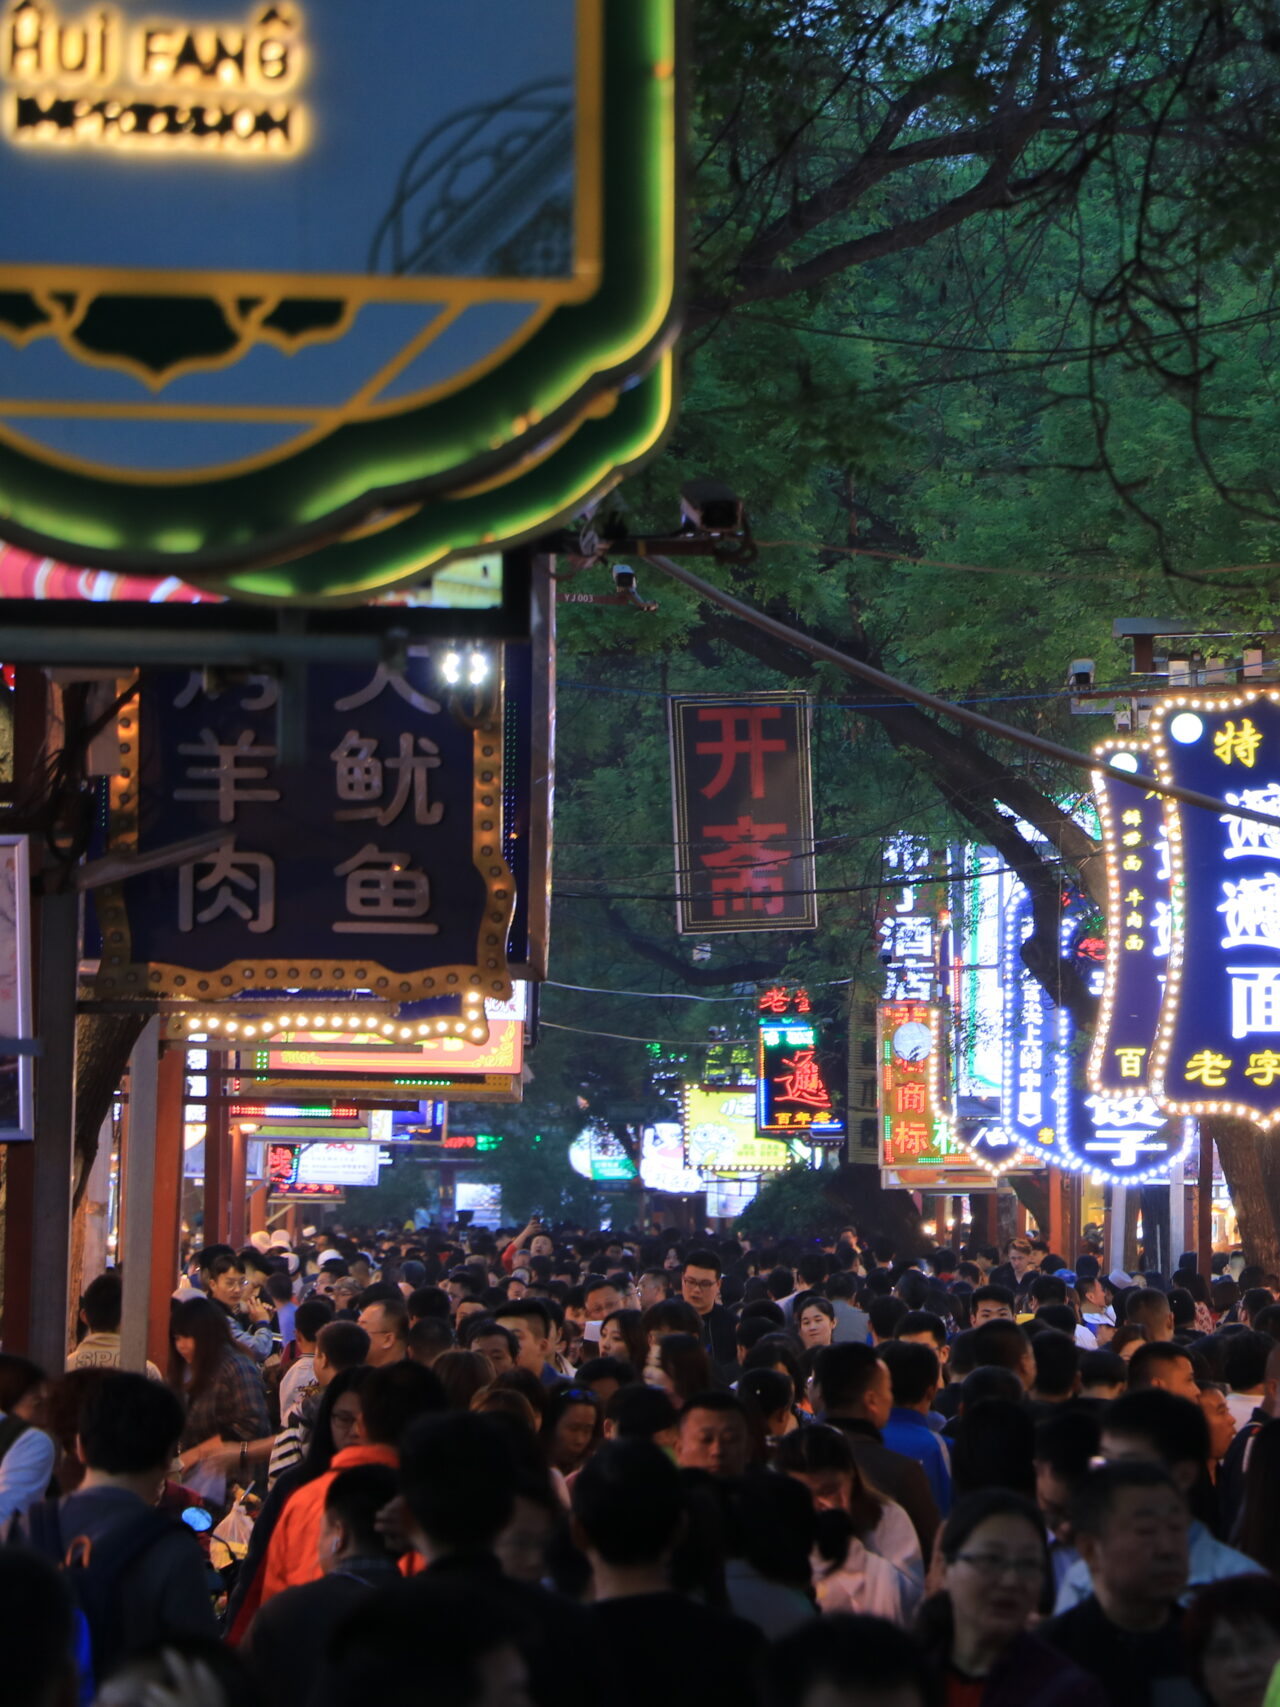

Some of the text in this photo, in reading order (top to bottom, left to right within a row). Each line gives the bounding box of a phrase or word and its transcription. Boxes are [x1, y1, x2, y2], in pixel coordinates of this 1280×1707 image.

[1115, 1048, 1146, 1078] 百
[774, 1111, 838, 1124] 百年老
